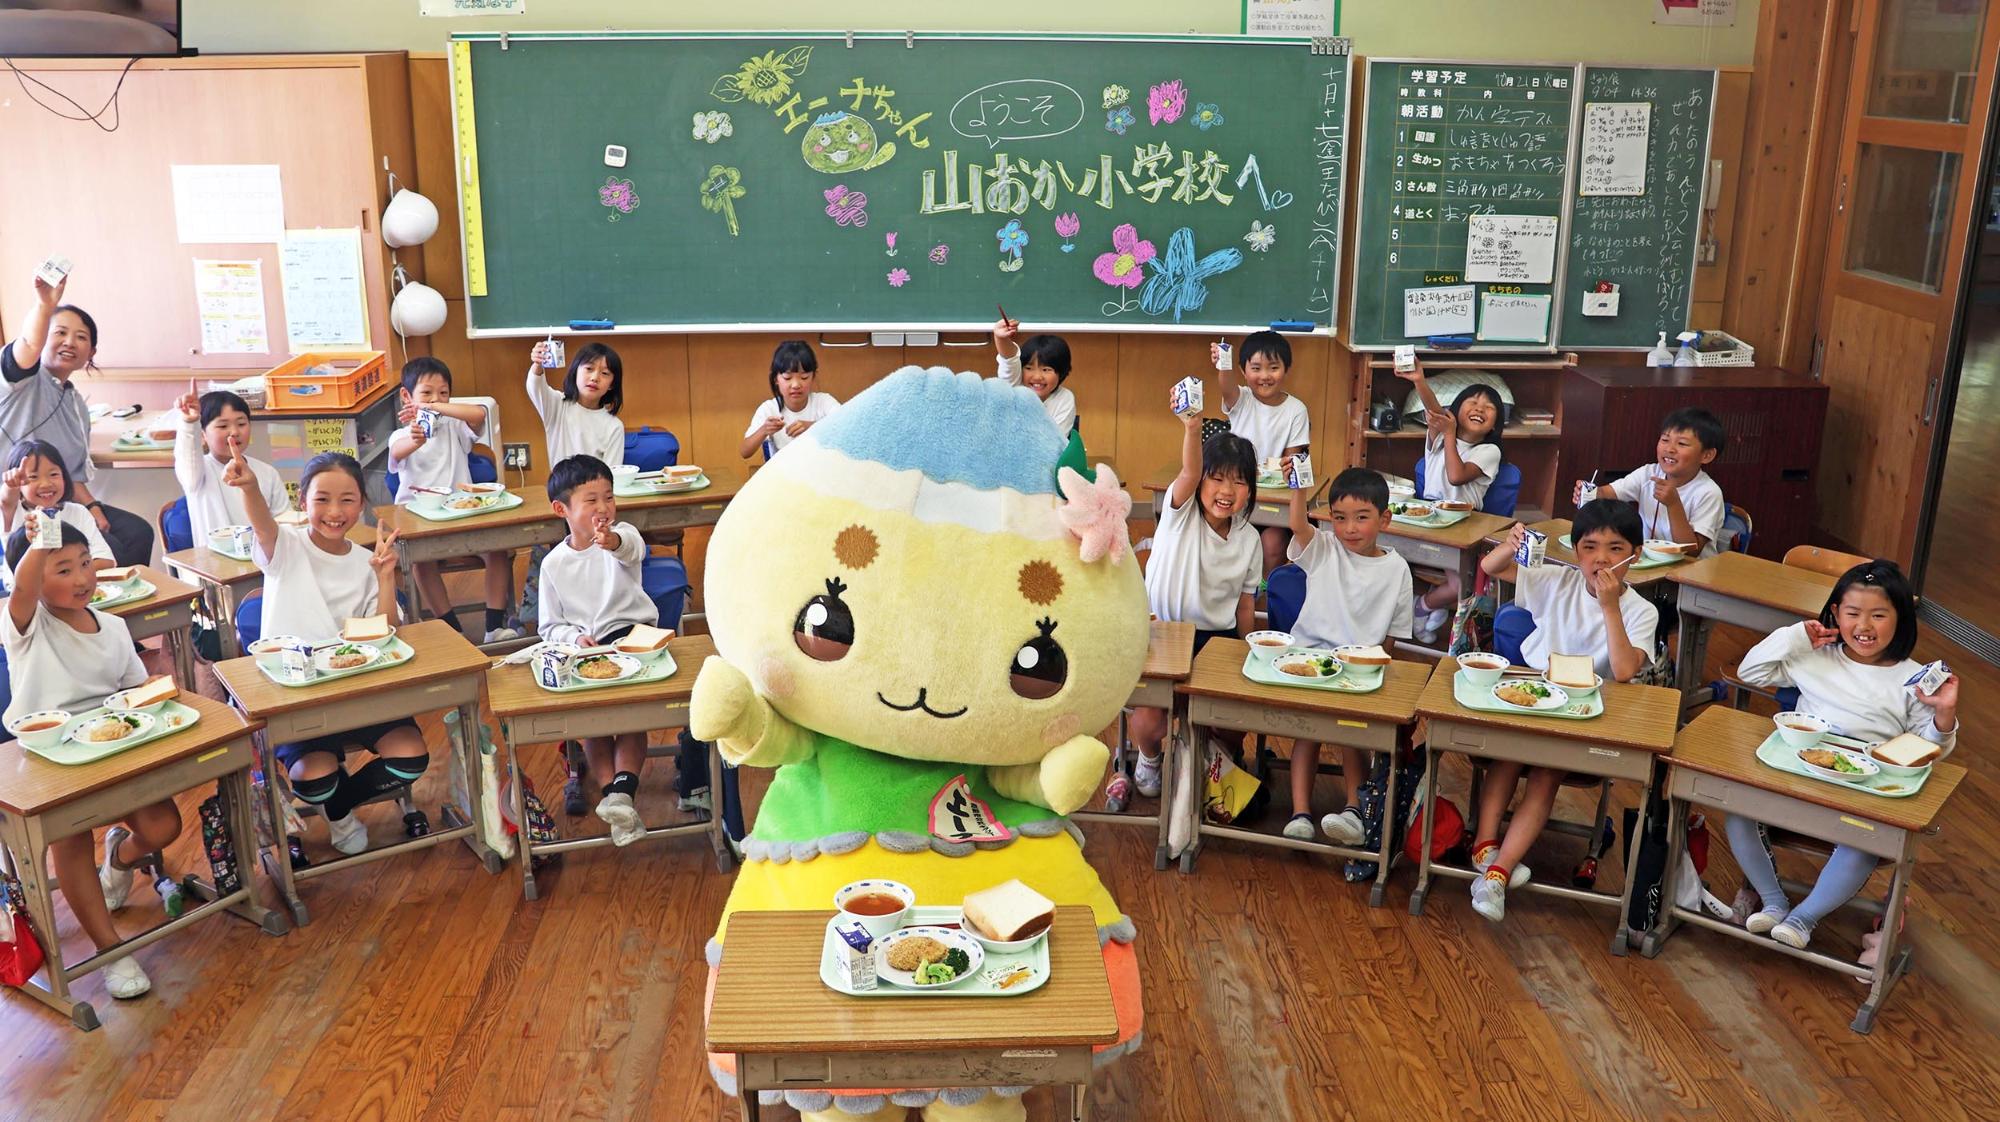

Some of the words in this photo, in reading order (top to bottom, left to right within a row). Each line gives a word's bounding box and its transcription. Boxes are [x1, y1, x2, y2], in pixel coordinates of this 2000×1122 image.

[1411, 70, 1467, 84] 学習予定
[775, 77, 933, 149] エーナちゃん
[968, 93, 1056, 128] ようこそ
[1401, 105, 1444, 118] 朝活動
[1399, 131, 1404, 142] 1
[1414, 131, 1436, 143] 国語
[1396, 155, 1403, 167] 2
[1411, 153, 1442, 166] 生かつ
[920, 142, 1271, 214] 山おか小学校へ
[1394, 180, 1402, 192] 3
[1406, 181, 1437, 193] さん数
[1393, 205, 1400, 216] 4
[1404, 208, 1434, 219] 道とく
[1391, 229, 1399, 240] 5
[1390, 252, 1398, 264] 6
